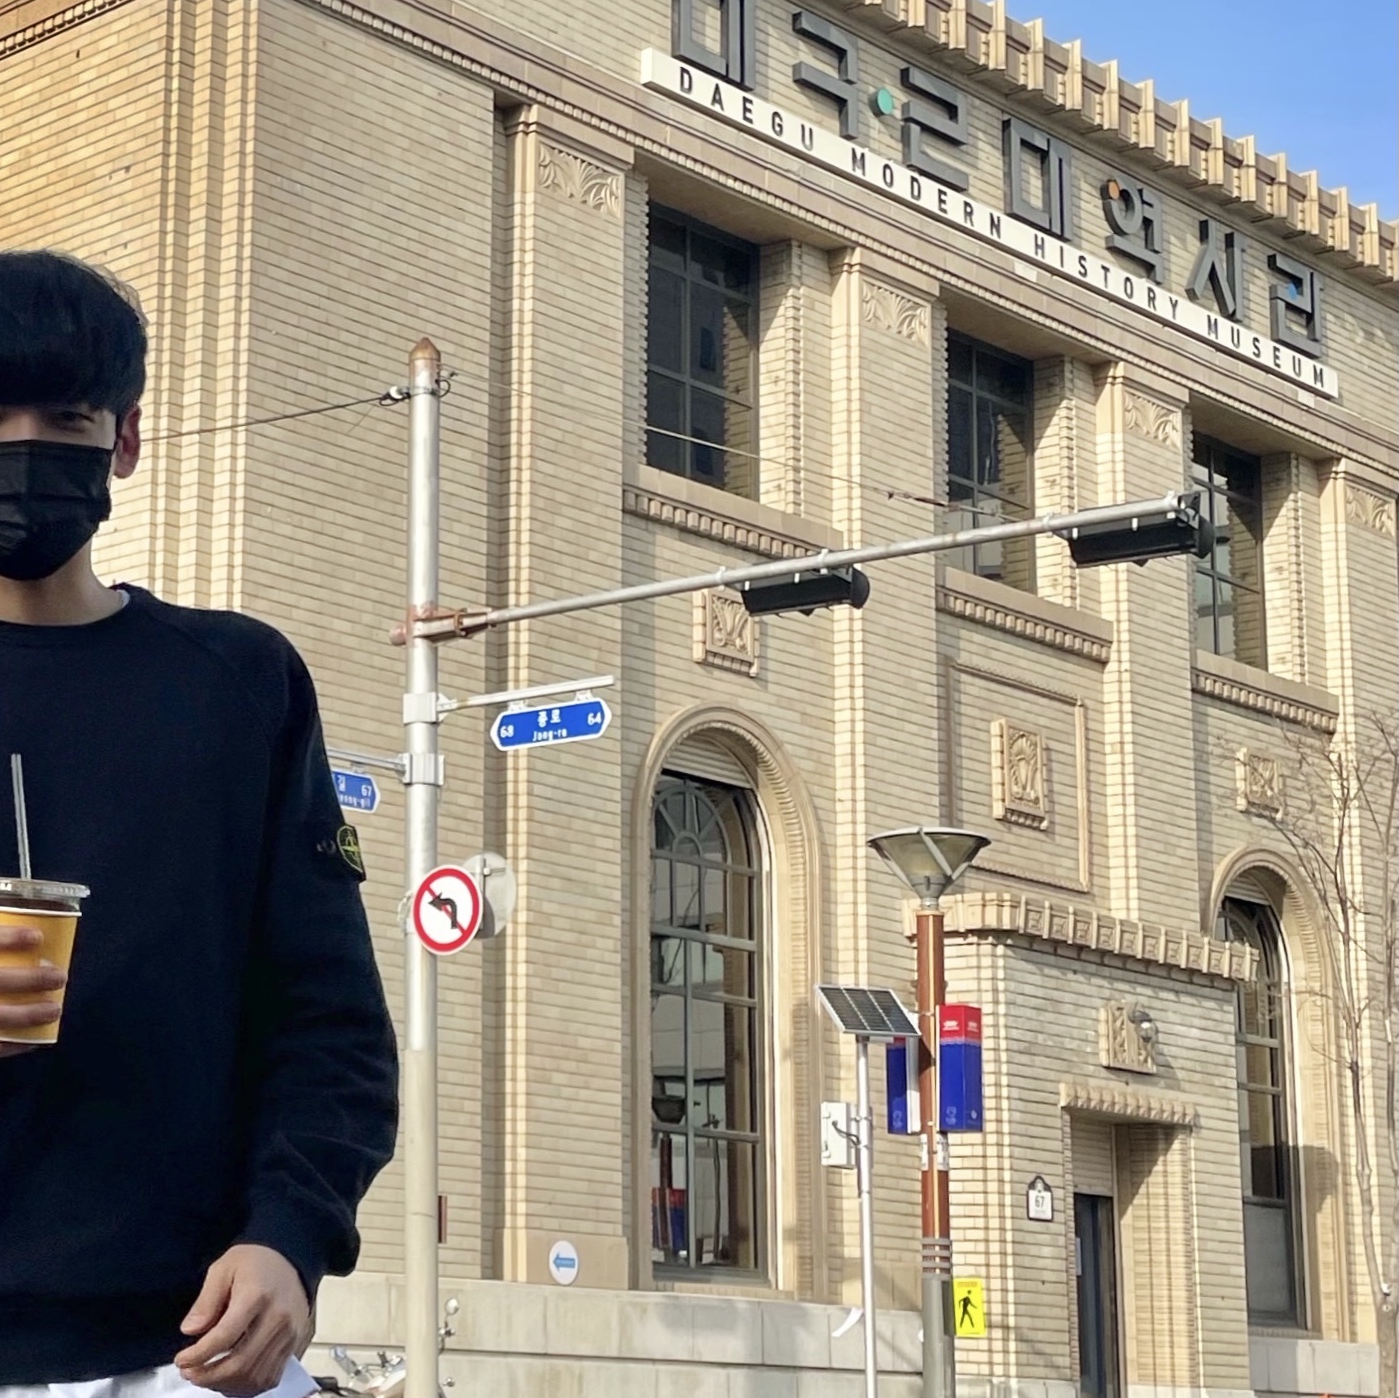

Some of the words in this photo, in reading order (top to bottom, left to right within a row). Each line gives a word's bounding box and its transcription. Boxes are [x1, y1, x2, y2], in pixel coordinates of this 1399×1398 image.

[679, 65, 814, 152] DAEGU
[851, 147, 1002, 240] MODERN
[1034, 233, 1179, 320] HISTORY
[1207, 314, 1326, 388] MUSEUM
[537, 709, 562, 728] 종로
[587, 711, 602, 726] 64
[500, 724, 515, 739] 68
[532, 728, 568, 742] Jong-ro
[361, 784, 373, 797] 67
[1034, 1194, 1045, 1208] 67
